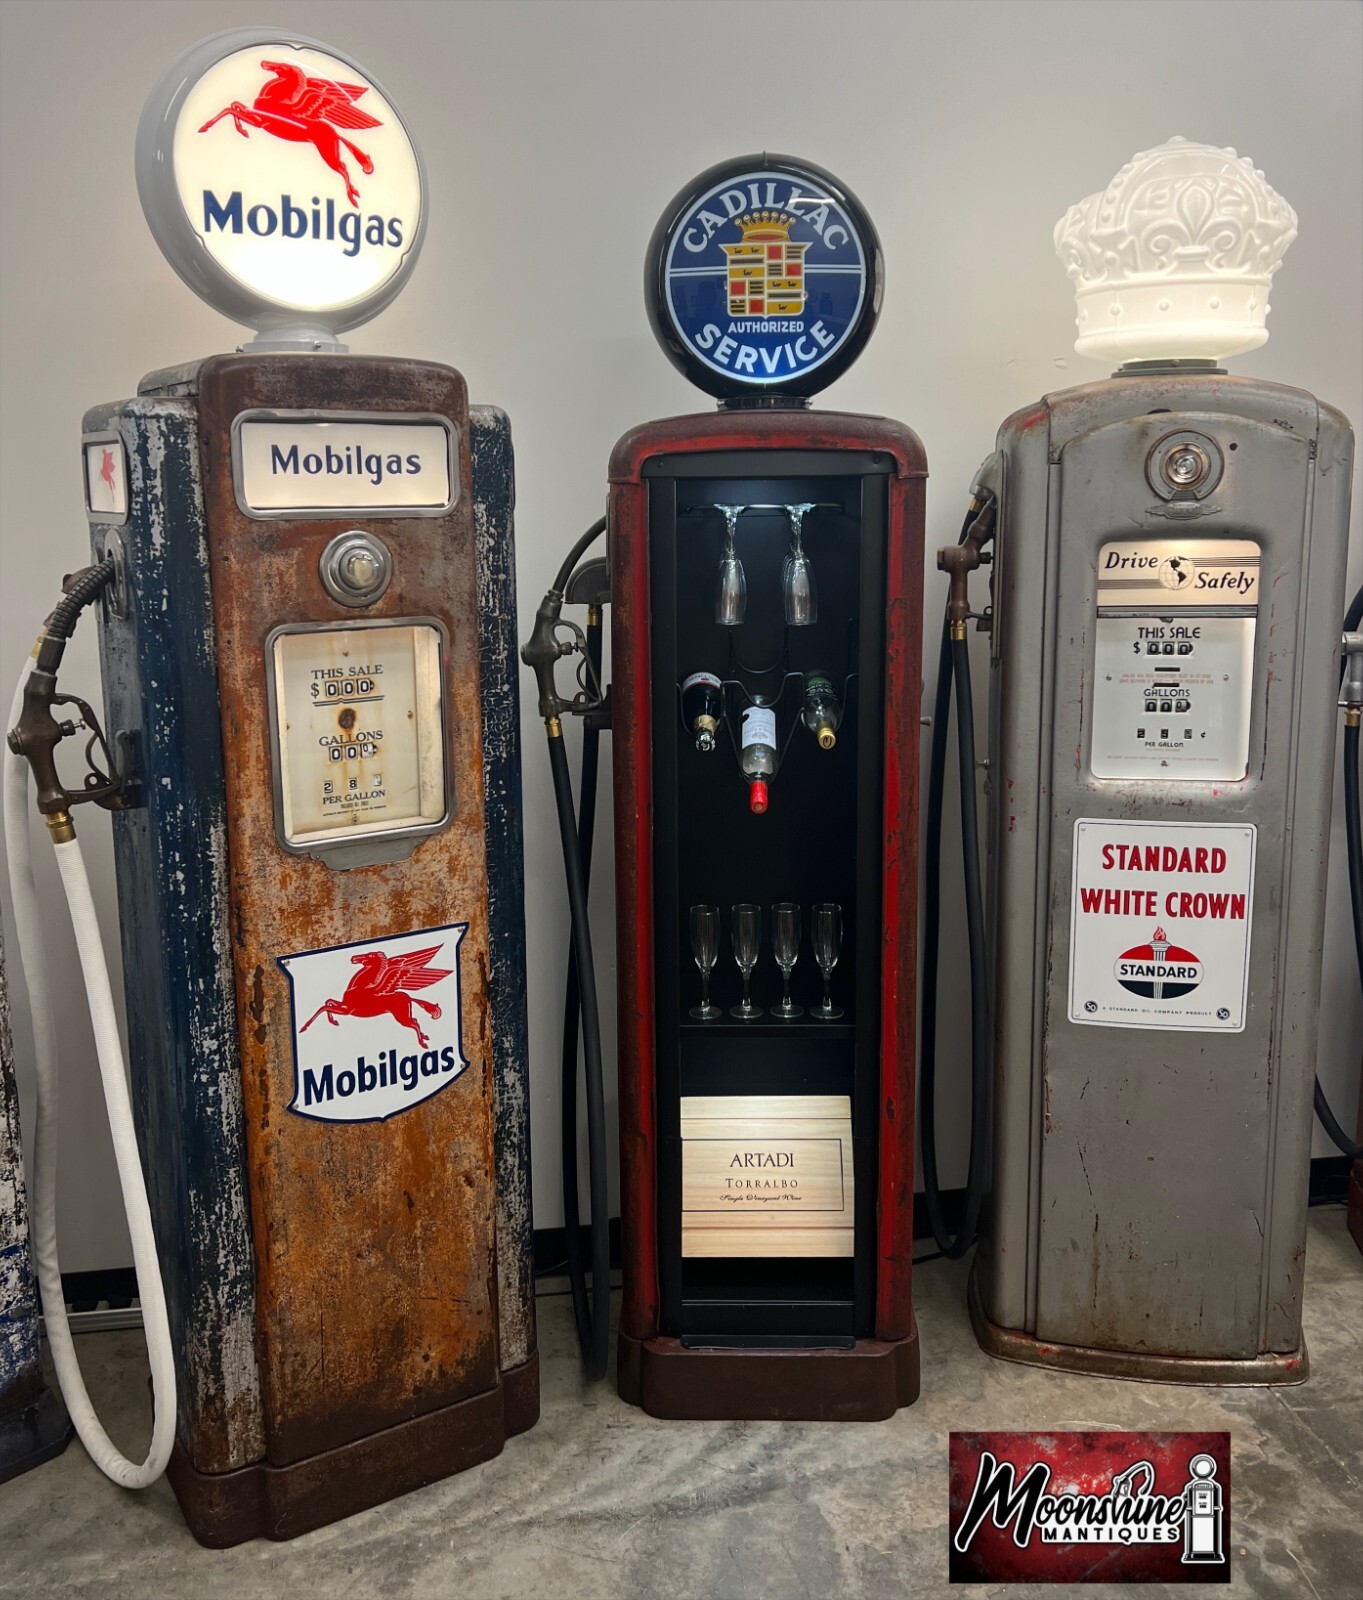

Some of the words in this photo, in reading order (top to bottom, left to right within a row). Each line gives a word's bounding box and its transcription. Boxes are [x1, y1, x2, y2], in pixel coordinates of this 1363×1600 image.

[203, 189, 403, 258] Mobilgas
[683, 182, 849, 253] CADILLAC
[727, 320, 804, 334] AUTHORIZED
[695, 320, 835, 374] SERVICE
[271, 444, 422, 486] Mobilgas
[1104, 551, 1159, 569] Drive
[1194, 571, 1255, 595] Safely
[1137, 626, 1165, 639] THIS
[1169, 626, 1201, 639] SALE
[310, 667, 344, 680] THIS
[348, 664, 384, 677] SALE
[310, 682, 320, 698] $
[1143, 688, 1191, 698] GALLONS
[319, 729, 384, 747] GALLONS
[322, 795, 342, 805] PER
[344, 788, 386, 802] GALLON
[1102, 843, 1227, 874] STANDARD
[1080, 887, 1158, 917] WHITE
[1165, 891, 1246, 920] CROWN
[1120, 963, 1198, 979] STANDARD
[303, 1046, 455, 1106] Mobilgas
[729, 1152, 795, 1168] ARTADI
[725, 1178, 798, 1189] TORRALBO
